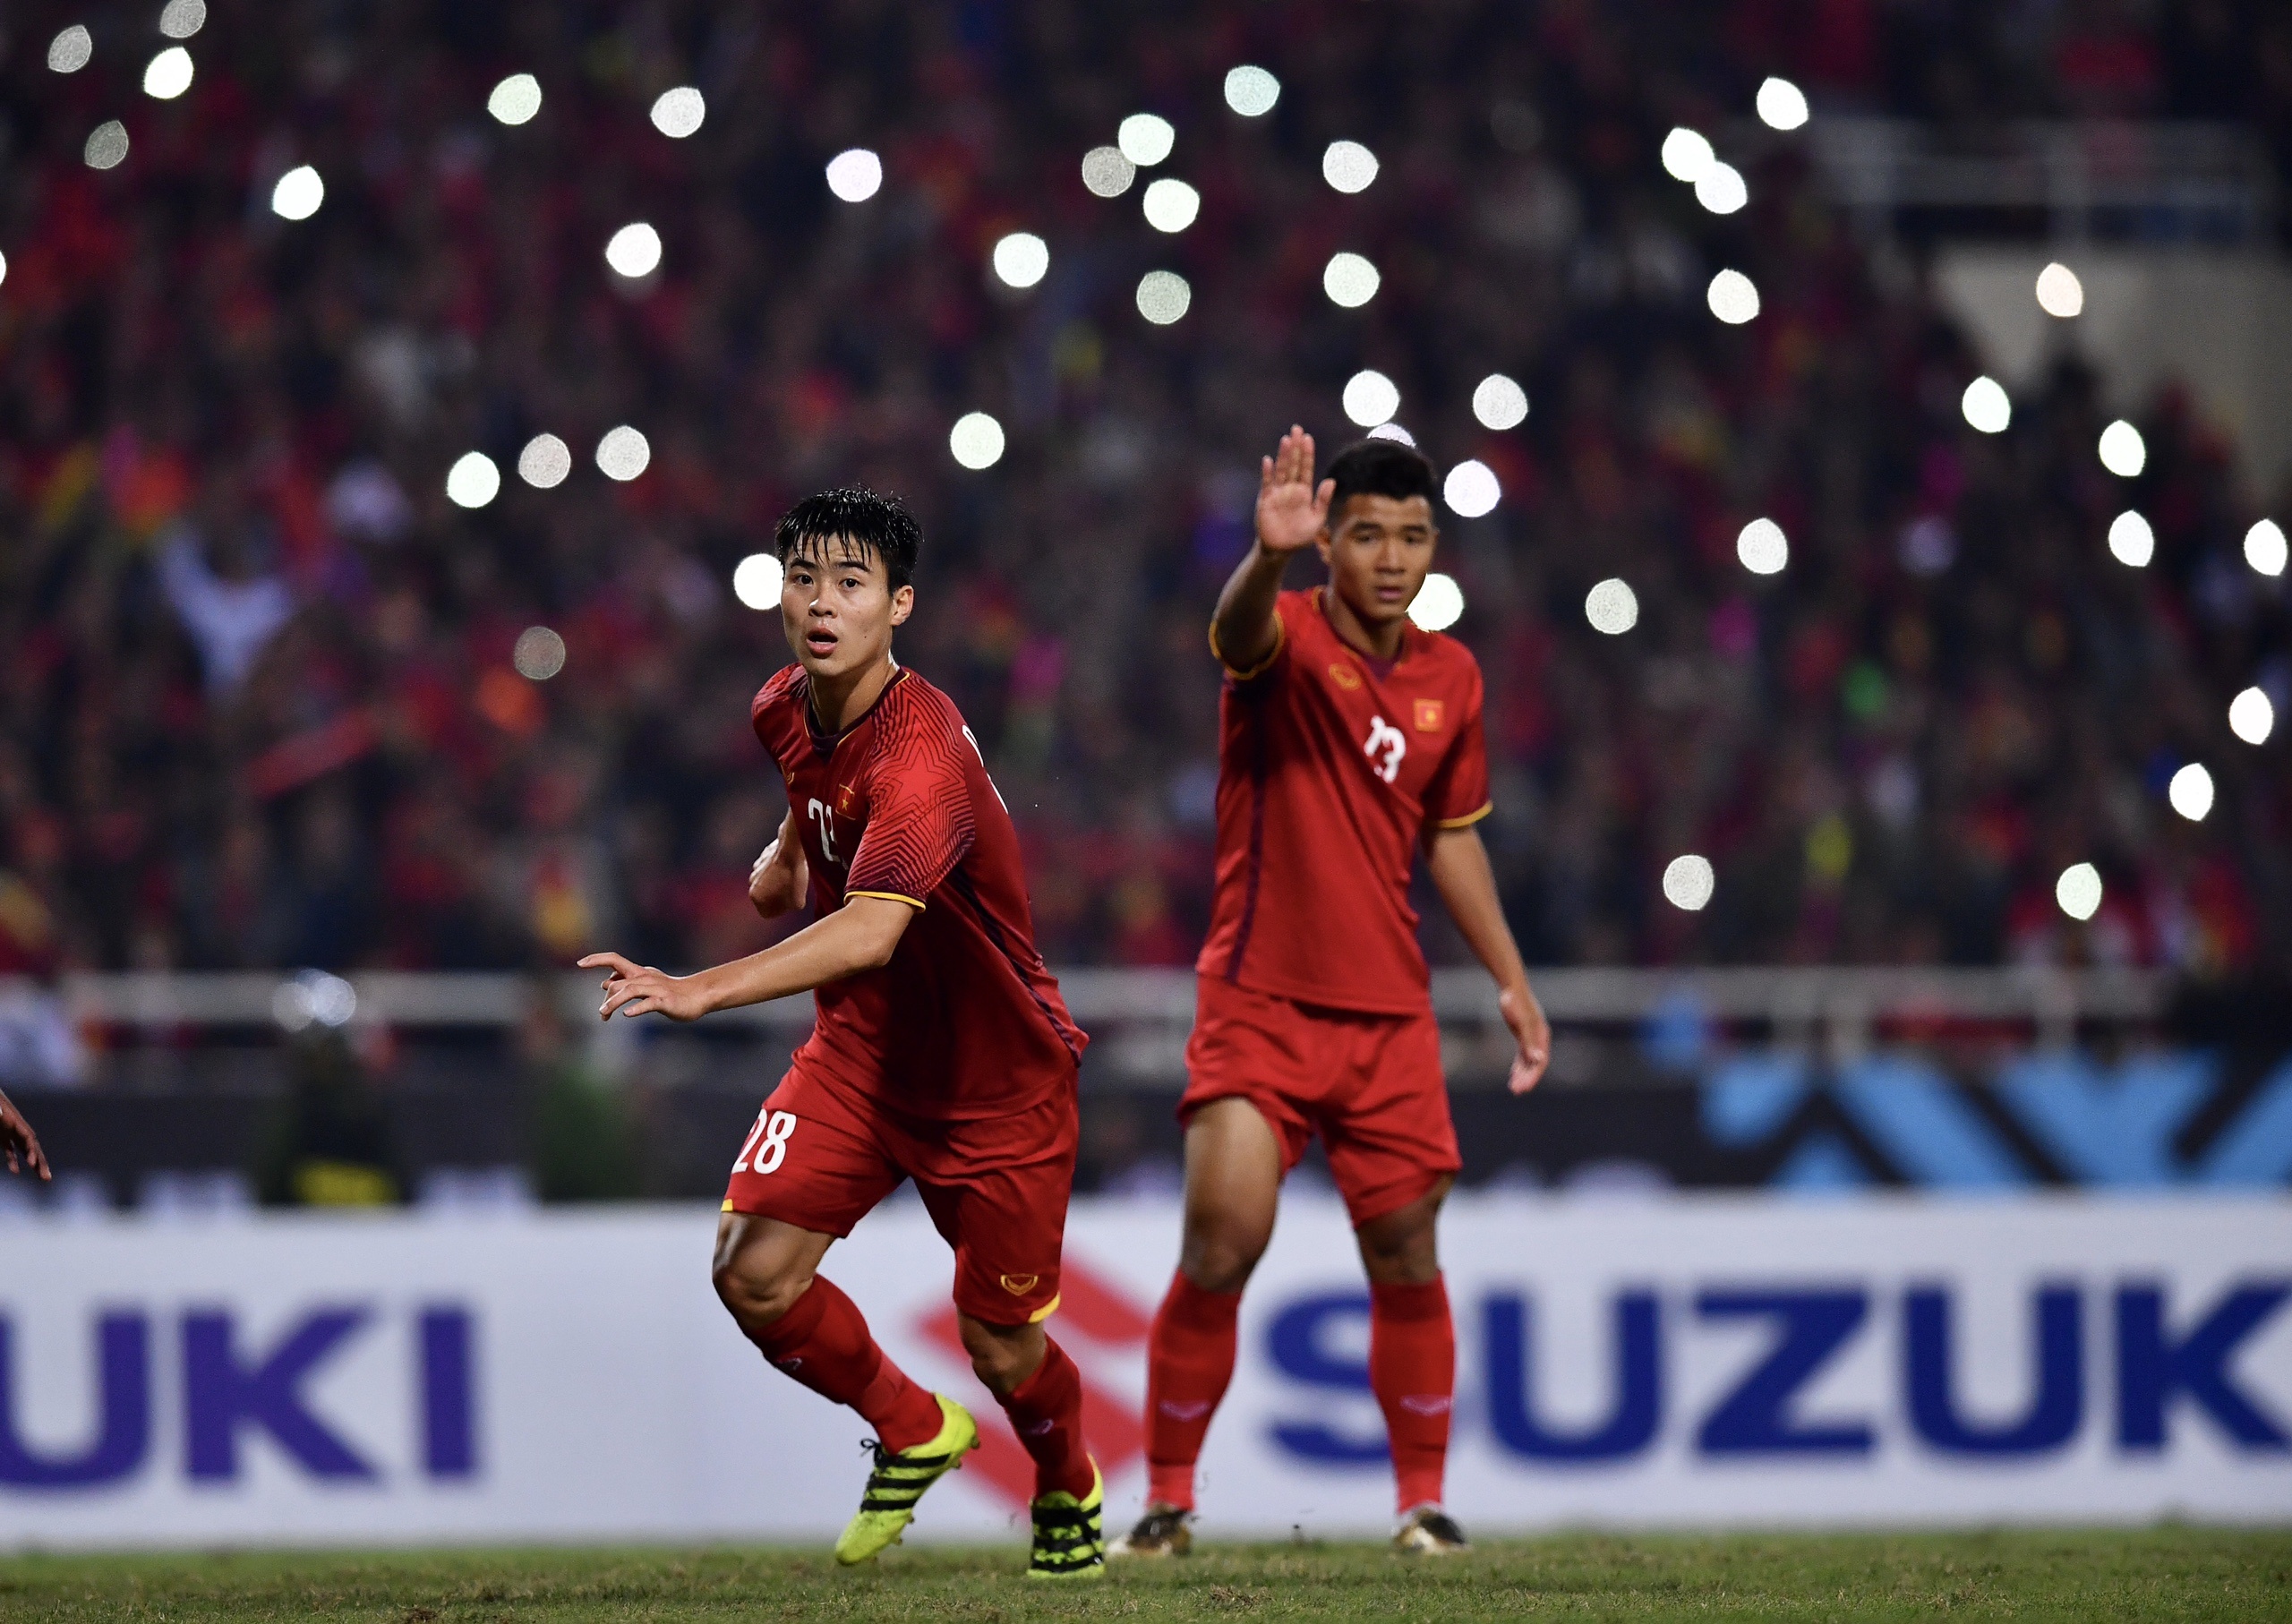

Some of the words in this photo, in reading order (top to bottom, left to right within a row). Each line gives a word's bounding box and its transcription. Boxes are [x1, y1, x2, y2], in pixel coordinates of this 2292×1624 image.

[731, 1108, 797, 1174] 28
[0, 1296, 483, 1500] UKI
[1260, 1278, 2292, 1474] SUZUK
